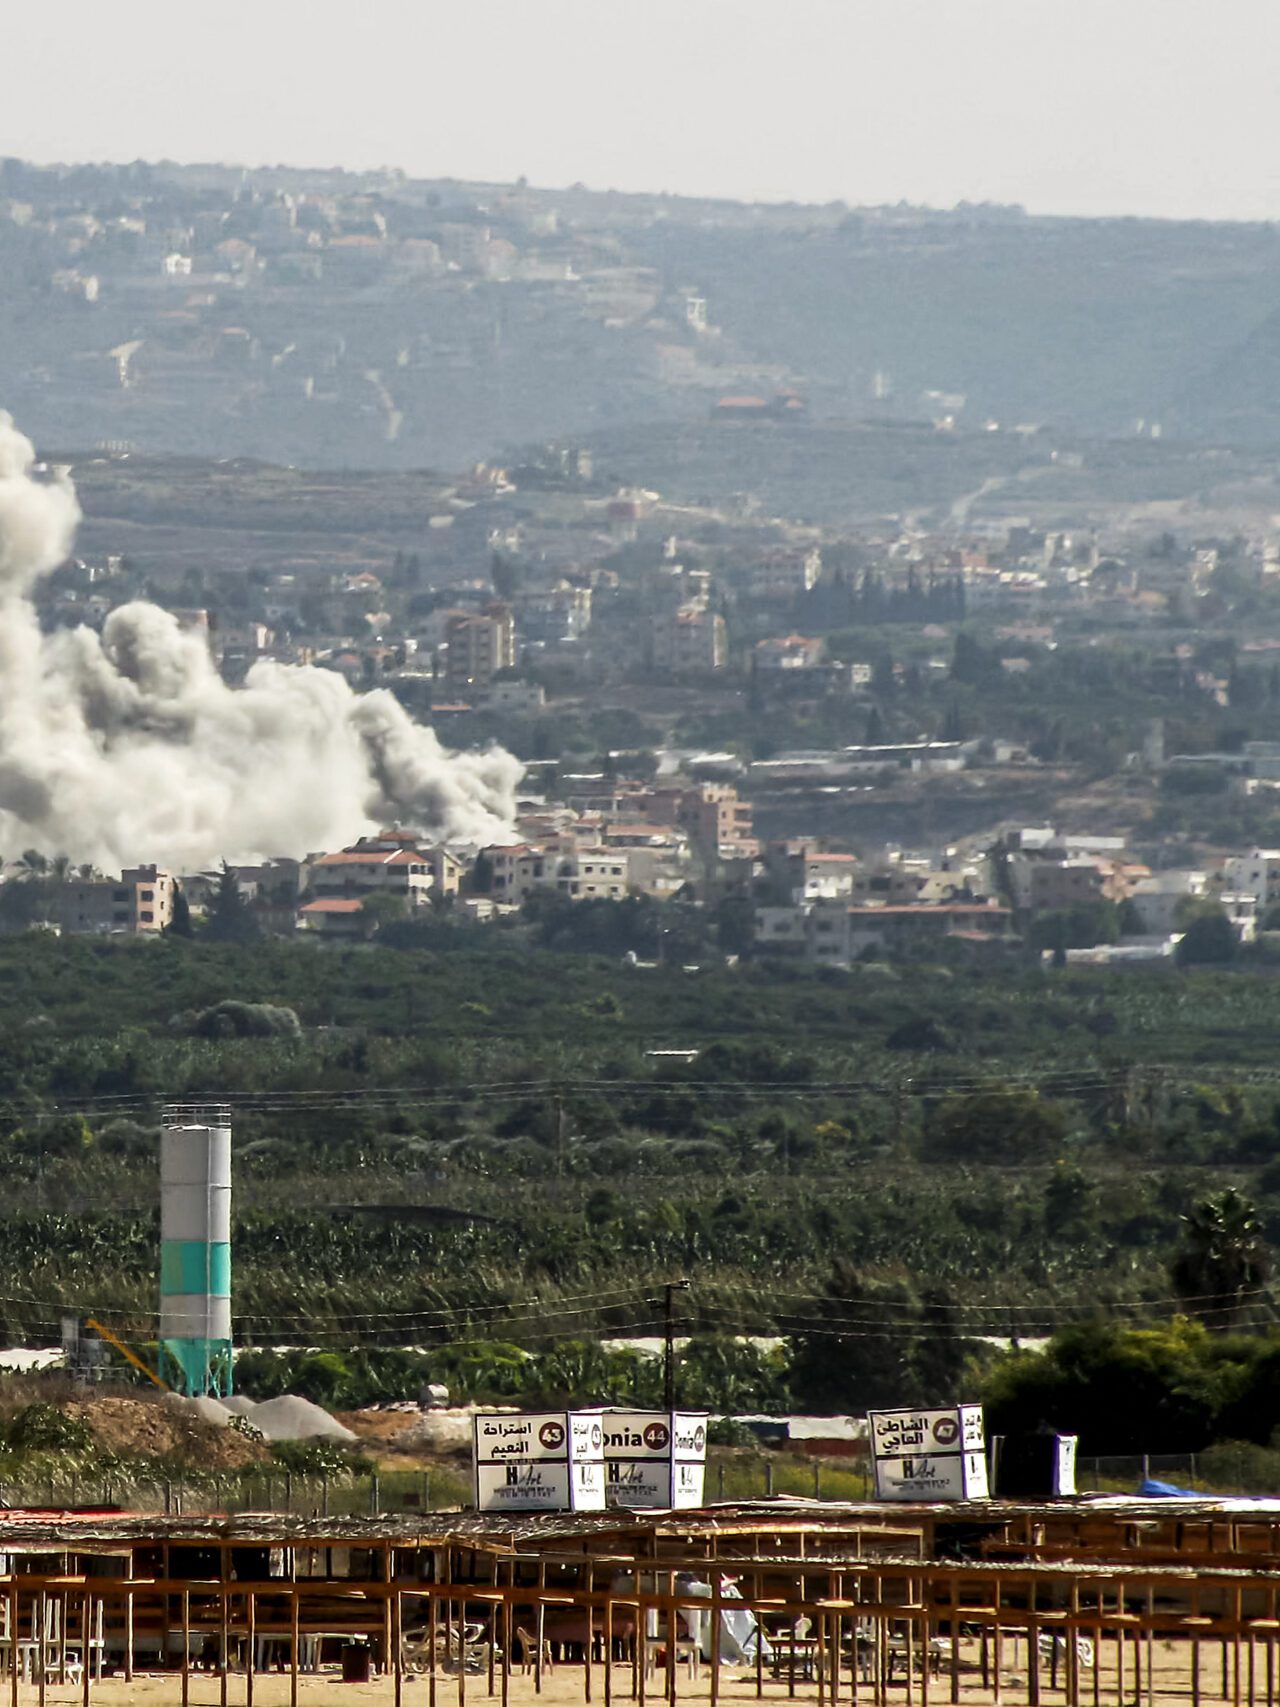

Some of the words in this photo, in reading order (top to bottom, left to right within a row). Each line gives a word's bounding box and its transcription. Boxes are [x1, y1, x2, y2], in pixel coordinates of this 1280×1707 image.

[483, 1422, 532, 1438] استراحة
[542, 1428, 561, 1442] 43
[647, 1429, 667, 1443] 44
[491, 1441, 529, 1458] النعيم
